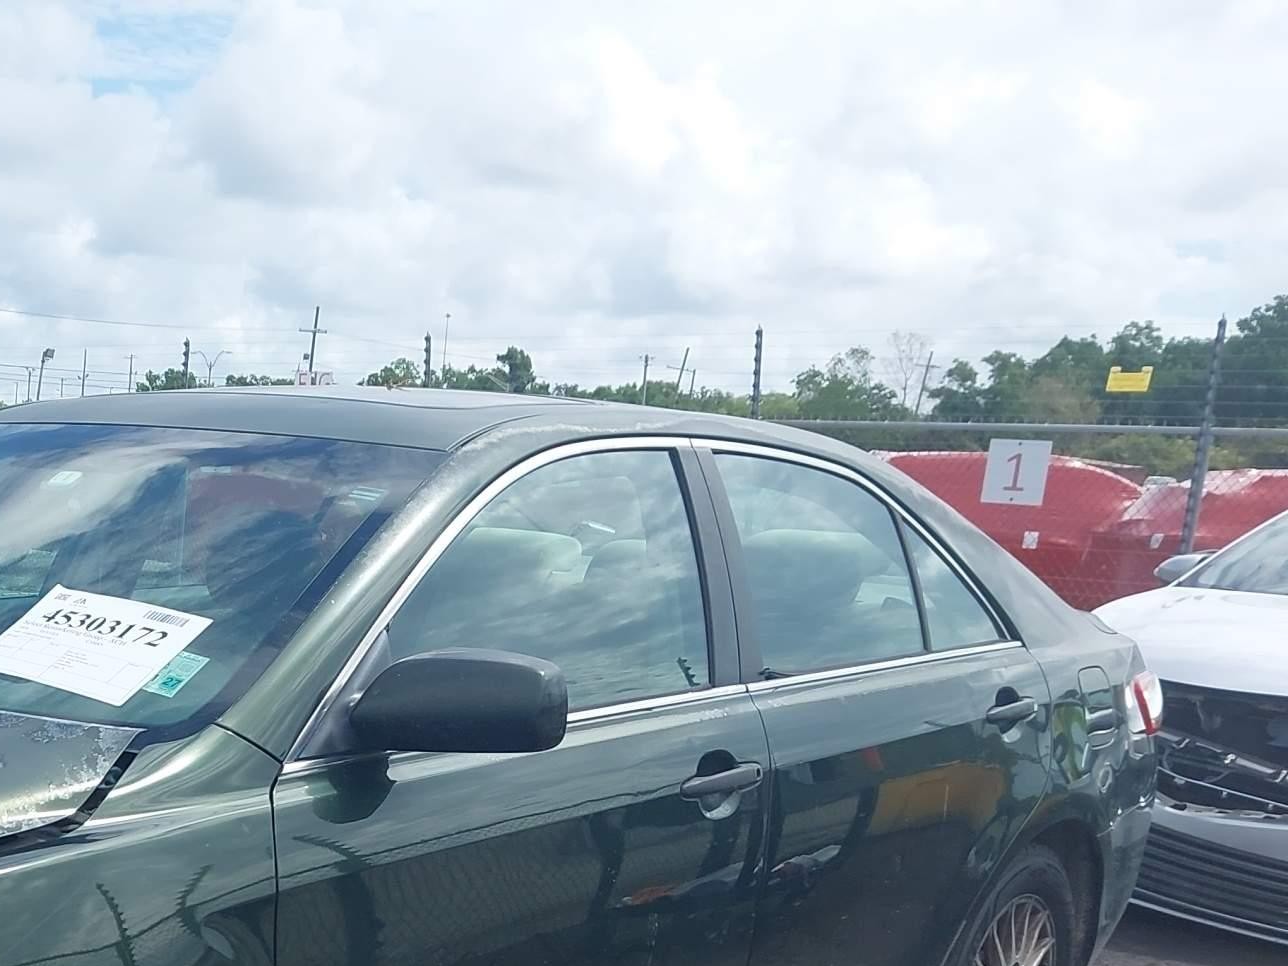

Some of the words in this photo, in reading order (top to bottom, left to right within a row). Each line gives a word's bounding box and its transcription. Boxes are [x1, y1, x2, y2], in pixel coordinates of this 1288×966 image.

[1002, 452, 1025, 492] 1
[41, 608, 169, 648] 45303172
[161, 677, 183, 688] 27
